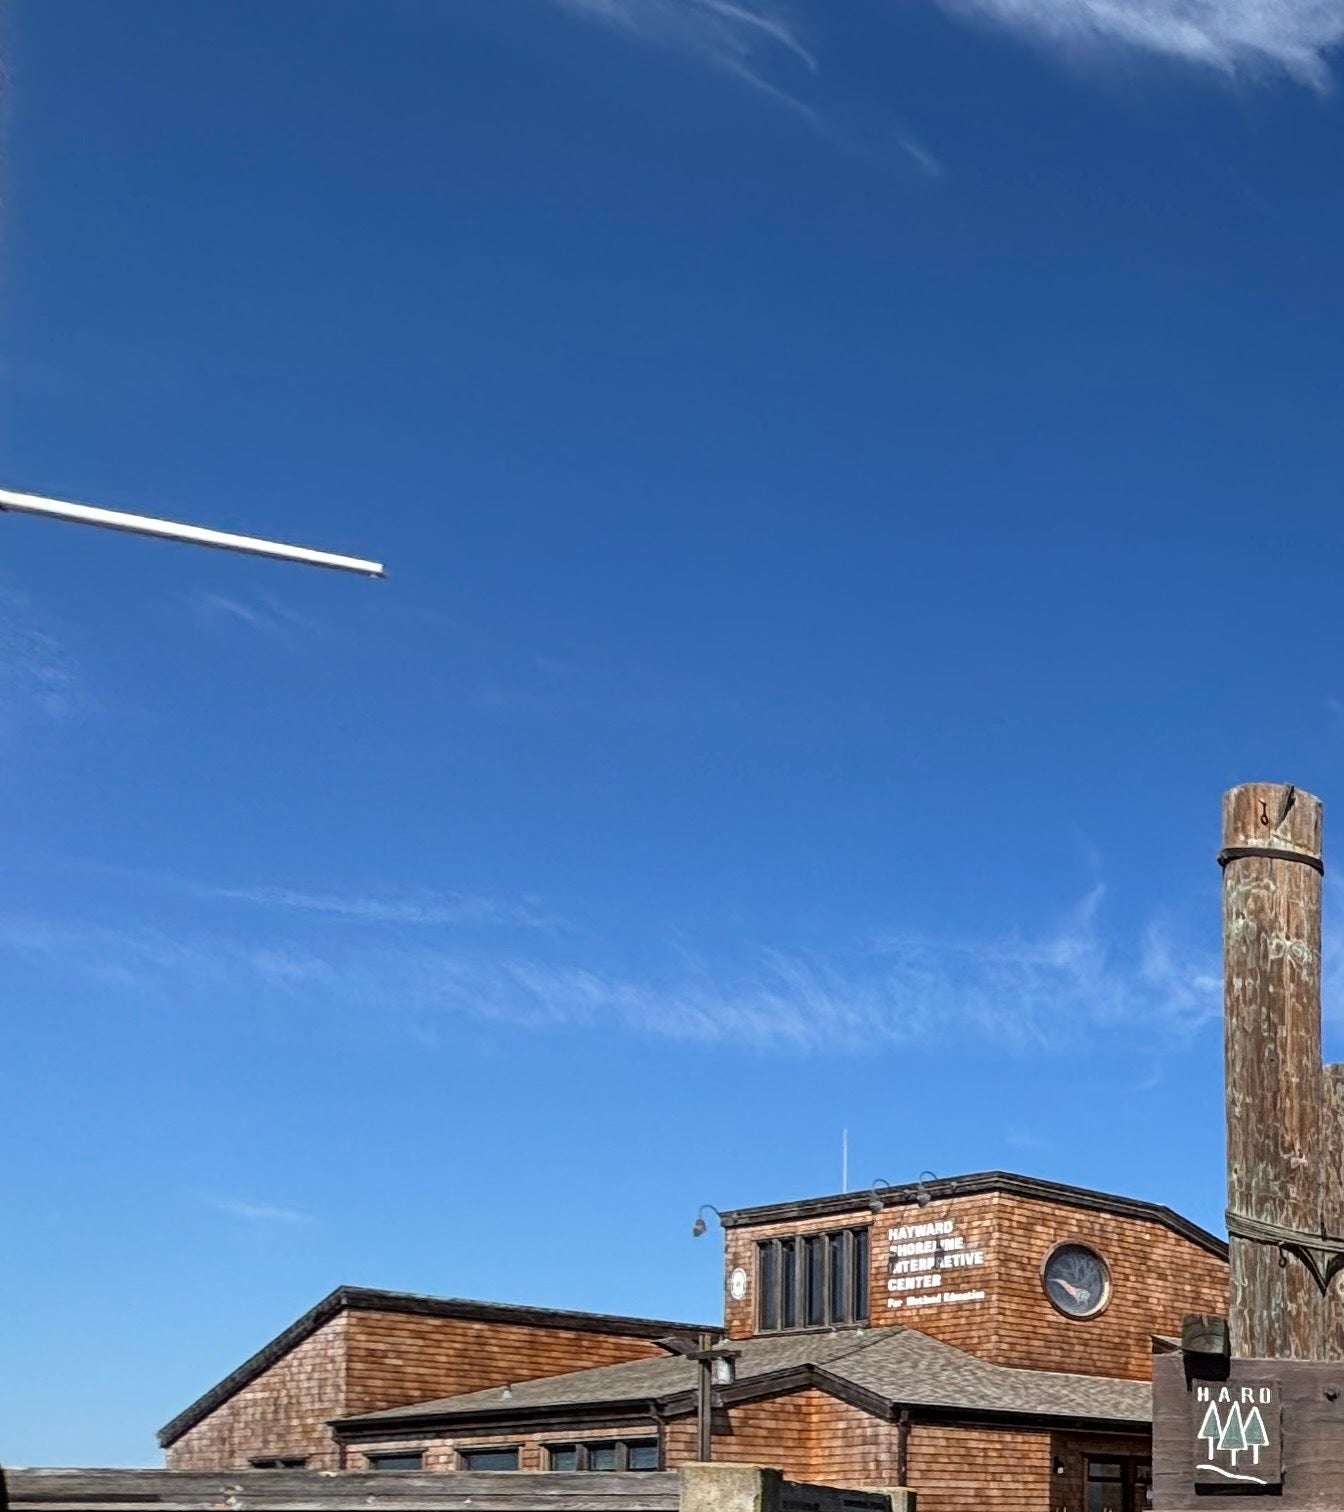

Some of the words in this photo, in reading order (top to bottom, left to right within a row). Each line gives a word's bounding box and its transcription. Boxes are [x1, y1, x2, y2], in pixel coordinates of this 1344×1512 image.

[888, 1220, 953, 1241] HAYWARD
[888, 1274, 941, 1291] CENTER
[1197, 1386, 1271, 1404] HARD
